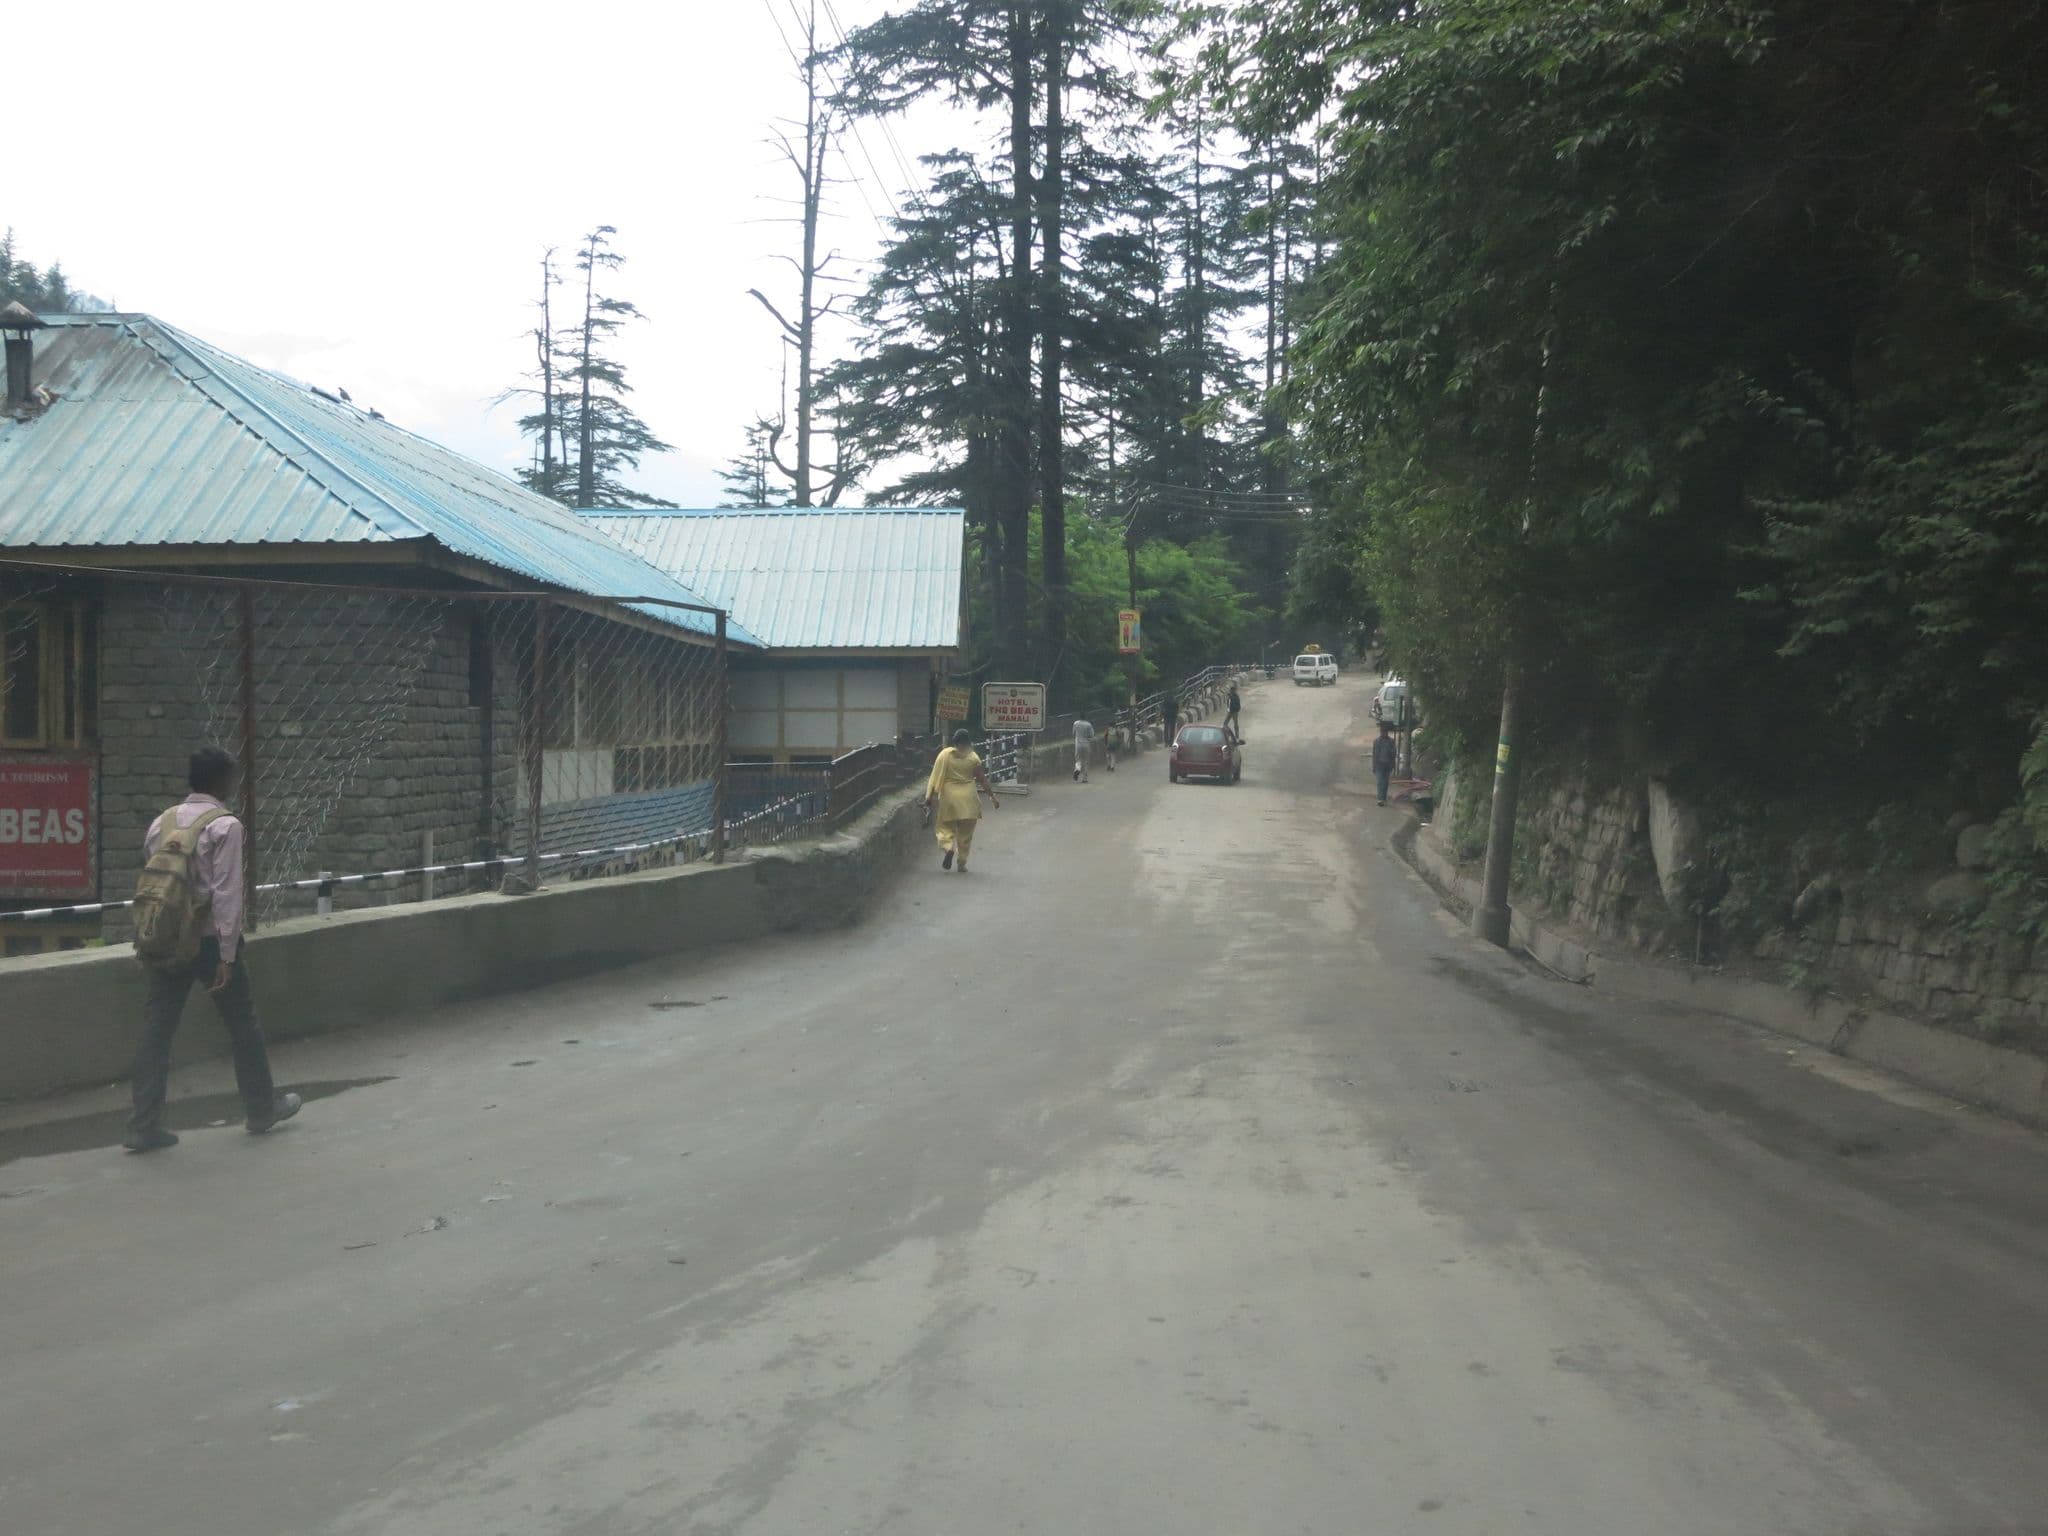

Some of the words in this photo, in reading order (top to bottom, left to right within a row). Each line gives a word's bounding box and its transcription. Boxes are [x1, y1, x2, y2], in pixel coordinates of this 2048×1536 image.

[998, 698, 1027, 706] HOTEL
[989, 706, 1008, 715] THE
[1010, 706, 1039, 715] BEAS
[998, 715, 1029, 723] MANALI
[12, 772, 69, 784] TOURISM
[0, 808, 85, 844] BEAS
